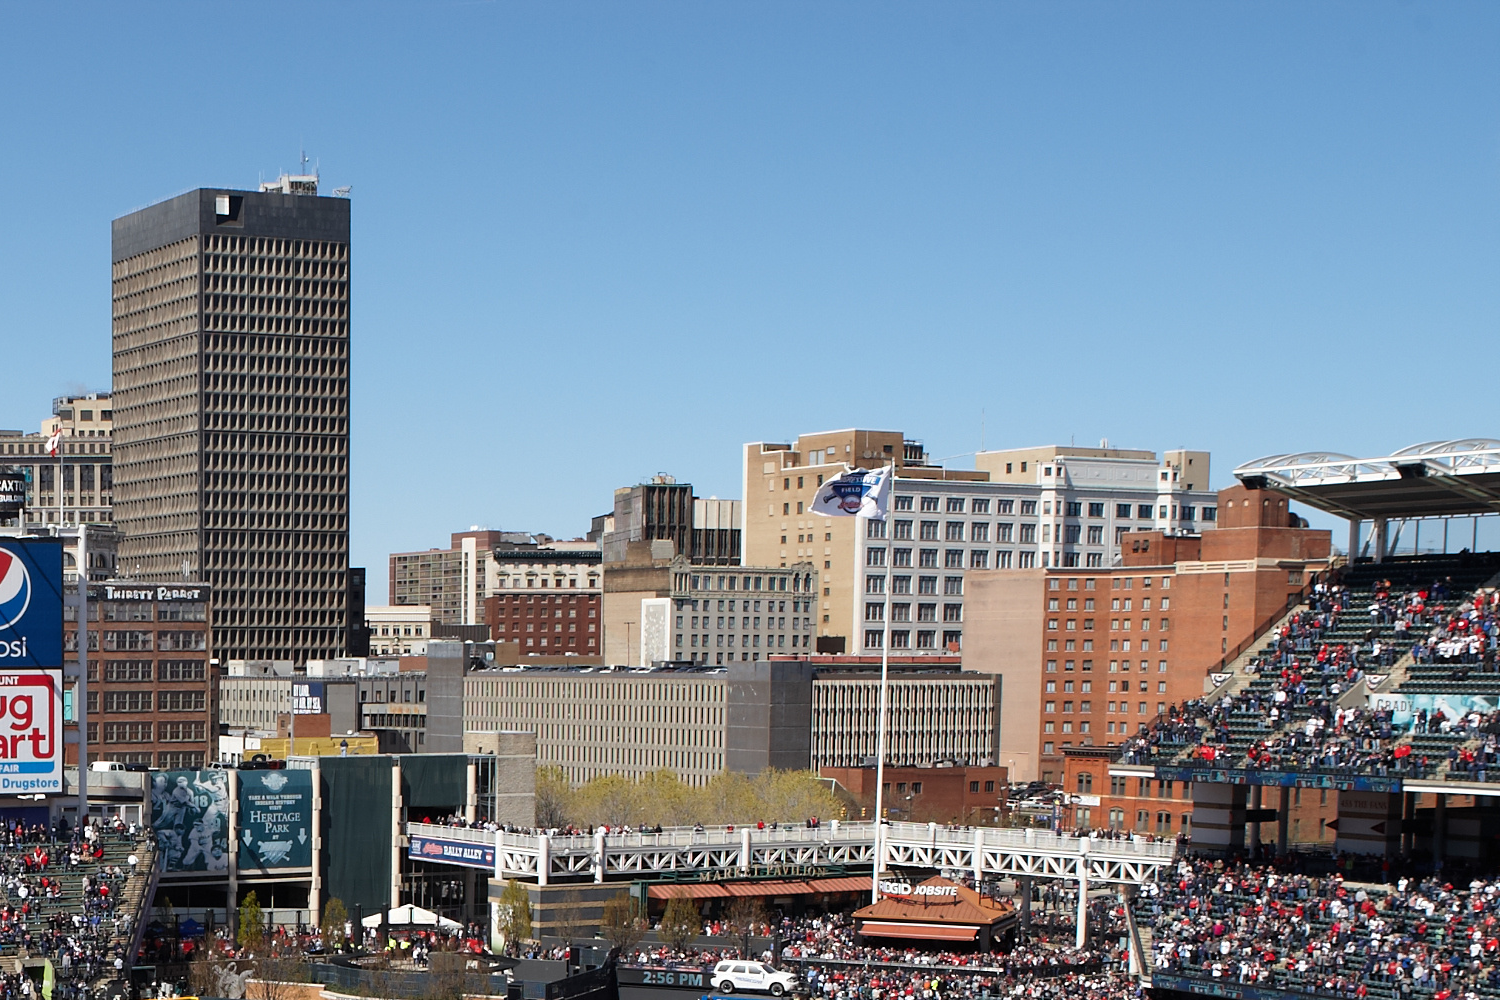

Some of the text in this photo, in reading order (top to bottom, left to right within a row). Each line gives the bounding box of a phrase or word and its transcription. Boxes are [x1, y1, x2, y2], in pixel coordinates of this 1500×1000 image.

[2, 778, 59, 791] Drugstore
[194, 795, 208, 807] 18
[250, 811, 301, 823] HERITAGE
[265, 822, 289, 833] PARK
[444, 846, 462, 857] RALLY
[463, 849, 482, 859] ALLEY
[700, 865, 827, 881] MARKET PAVILION
[914, 885, 958, 895] JOBSITE
[643, 972, 703, 986] 2:56 PM
